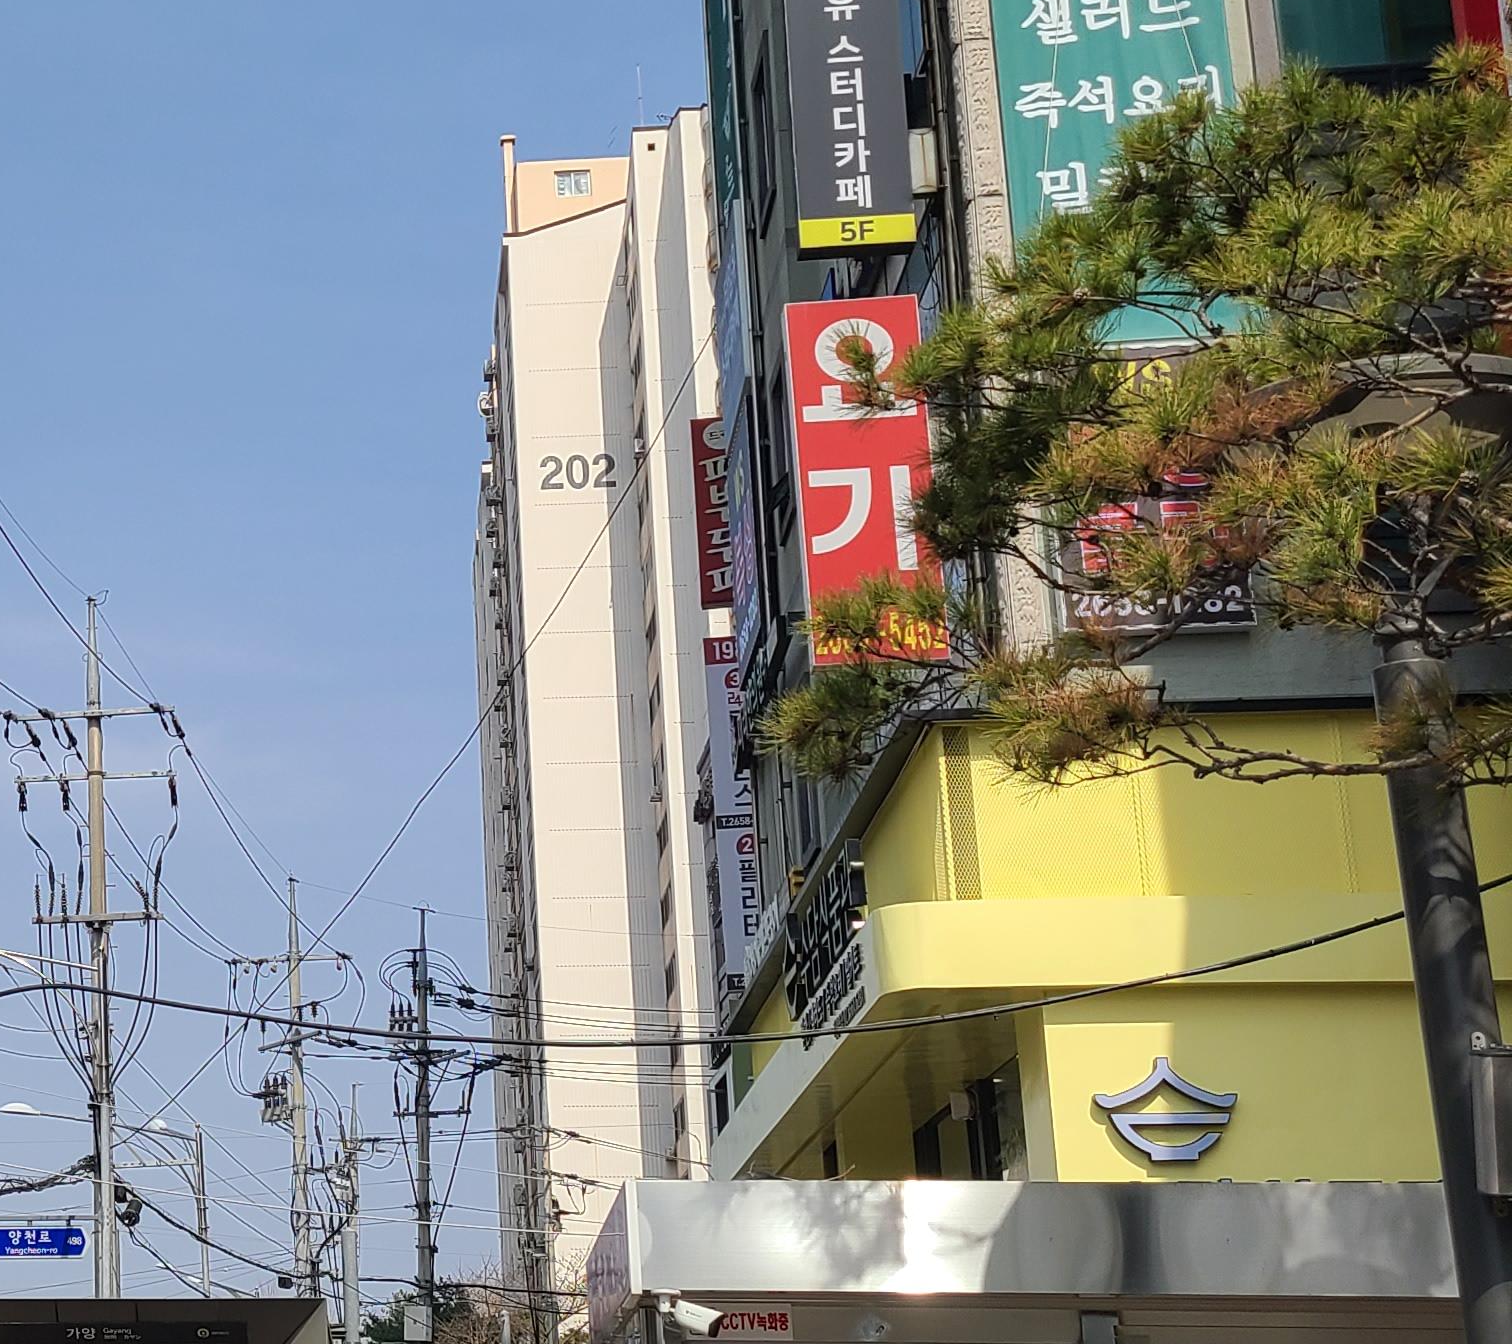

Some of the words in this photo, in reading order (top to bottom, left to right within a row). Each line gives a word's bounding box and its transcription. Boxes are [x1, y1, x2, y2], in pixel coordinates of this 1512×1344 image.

[827, 34, 874, 210] 스터디카페
[840, 220, 876, 243] 5F
[539, 453, 617, 491] 202
[8, 1230, 53, 1245] 양천로
[4, 1246, 58, 1256] Yangcheon-ro
[721, 1312, 789, 1332] CCTV녹화중
[65, 1327, 96, 1341] 가양
[102, 1327, 132, 1337] Gayang
